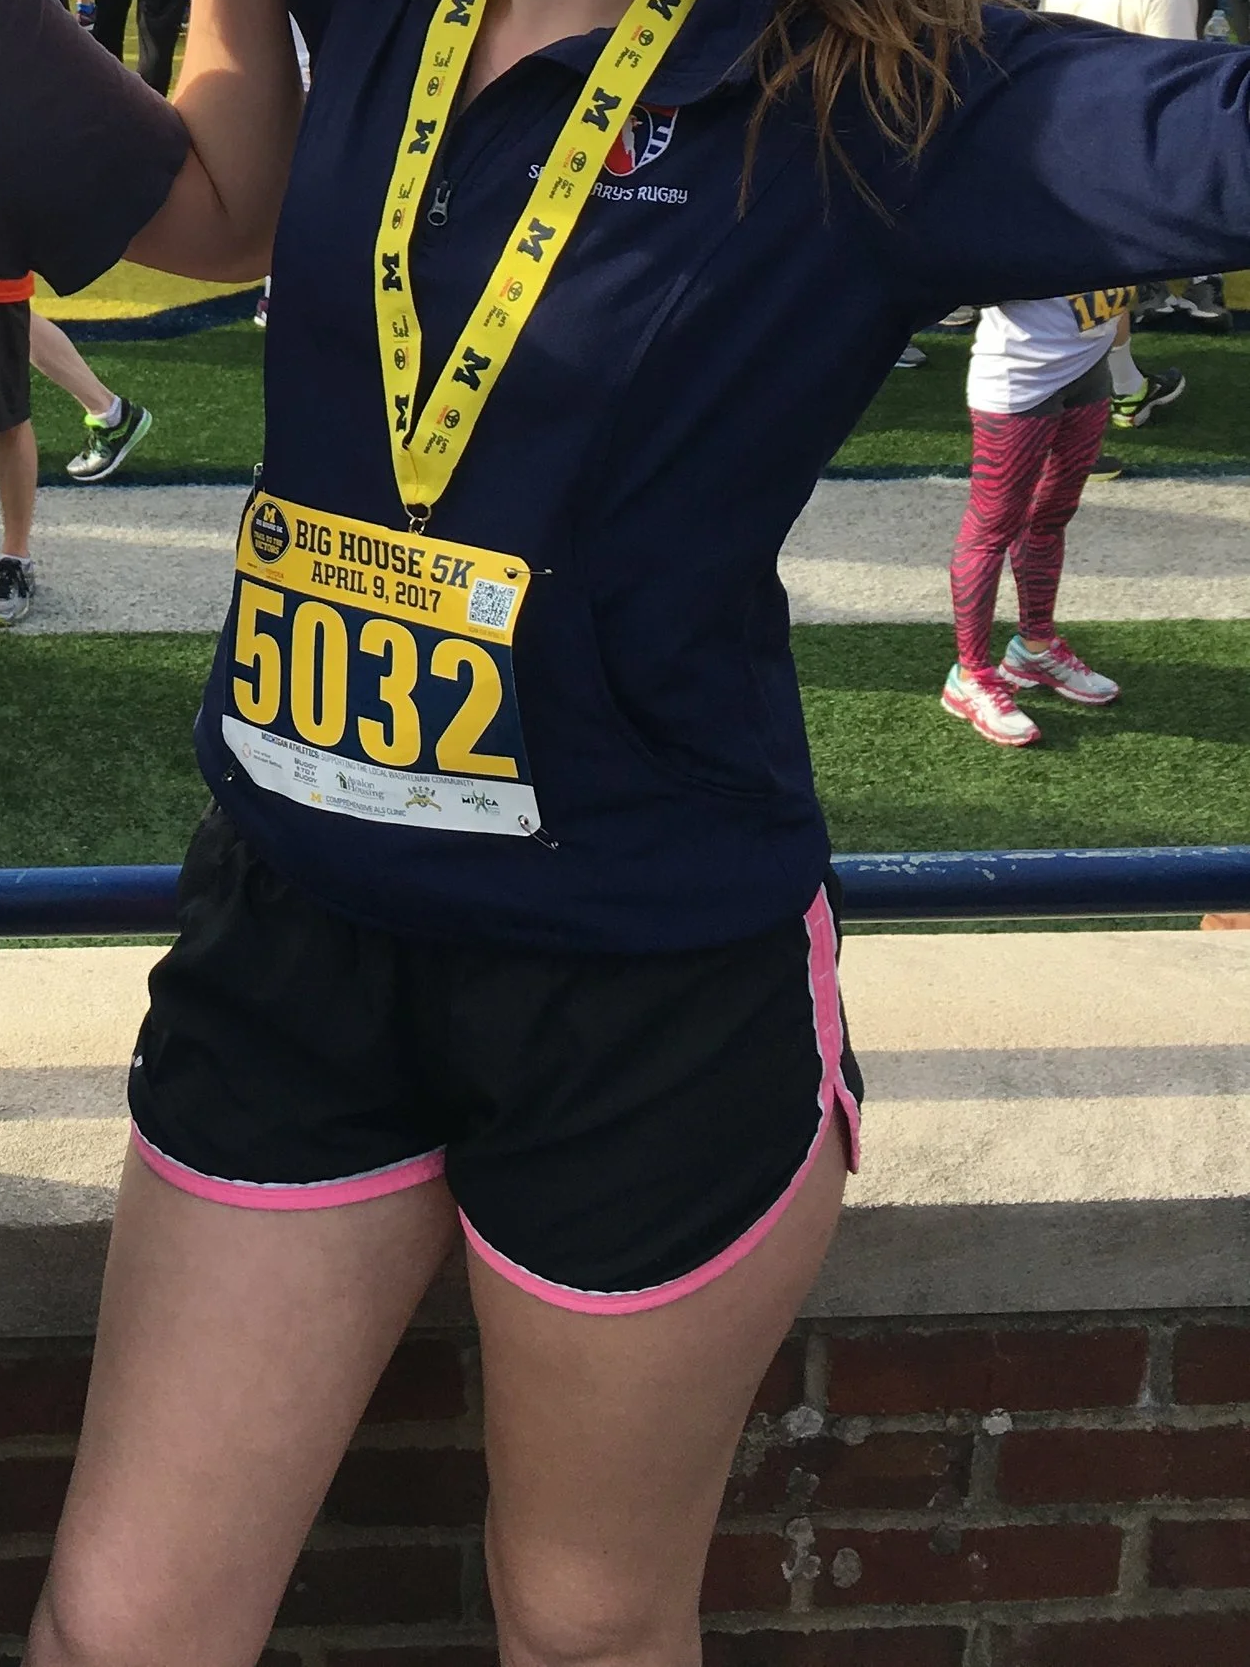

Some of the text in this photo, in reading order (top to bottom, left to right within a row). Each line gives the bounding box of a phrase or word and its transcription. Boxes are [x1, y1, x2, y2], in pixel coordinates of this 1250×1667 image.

[581, 86, 622, 132] M
[407, 118, 437, 155] M
[636, 186, 689, 204] RUGBY
[516, 217, 557, 263] M
[382, 251, 403, 292] M
[451, 346, 492, 391] M
[394, 394, 410, 432] M
[263, 505, 277, 524] M
[254, 538, 280, 555] VICTORS
[294, 518, 476, 590] BIG HOUSE 5K
[311, 560, 442, 613] APRIL 9, 2017
[232, 579, 519, 779] 5032
[261, 732, 289, 749] MICHIGAN
[319, 754, 357, 770] SUPPORTING
[356, 765, 368, 774] THE
[369, 767, 388, 778] LOCAL
[389, 771, 430, 783] WASHTENAW
[431, 775, 474, 787] COMMUNITY
[294, 757, 318, 771] BUDDY
[294, 771, 318, 783] BUDDY
[347, 775, 375, 789] Avalon
[347, 783, 385, 800] Housing
[310, 791, 407, 817] M COMPREHENSIVE ALS CLINIC
